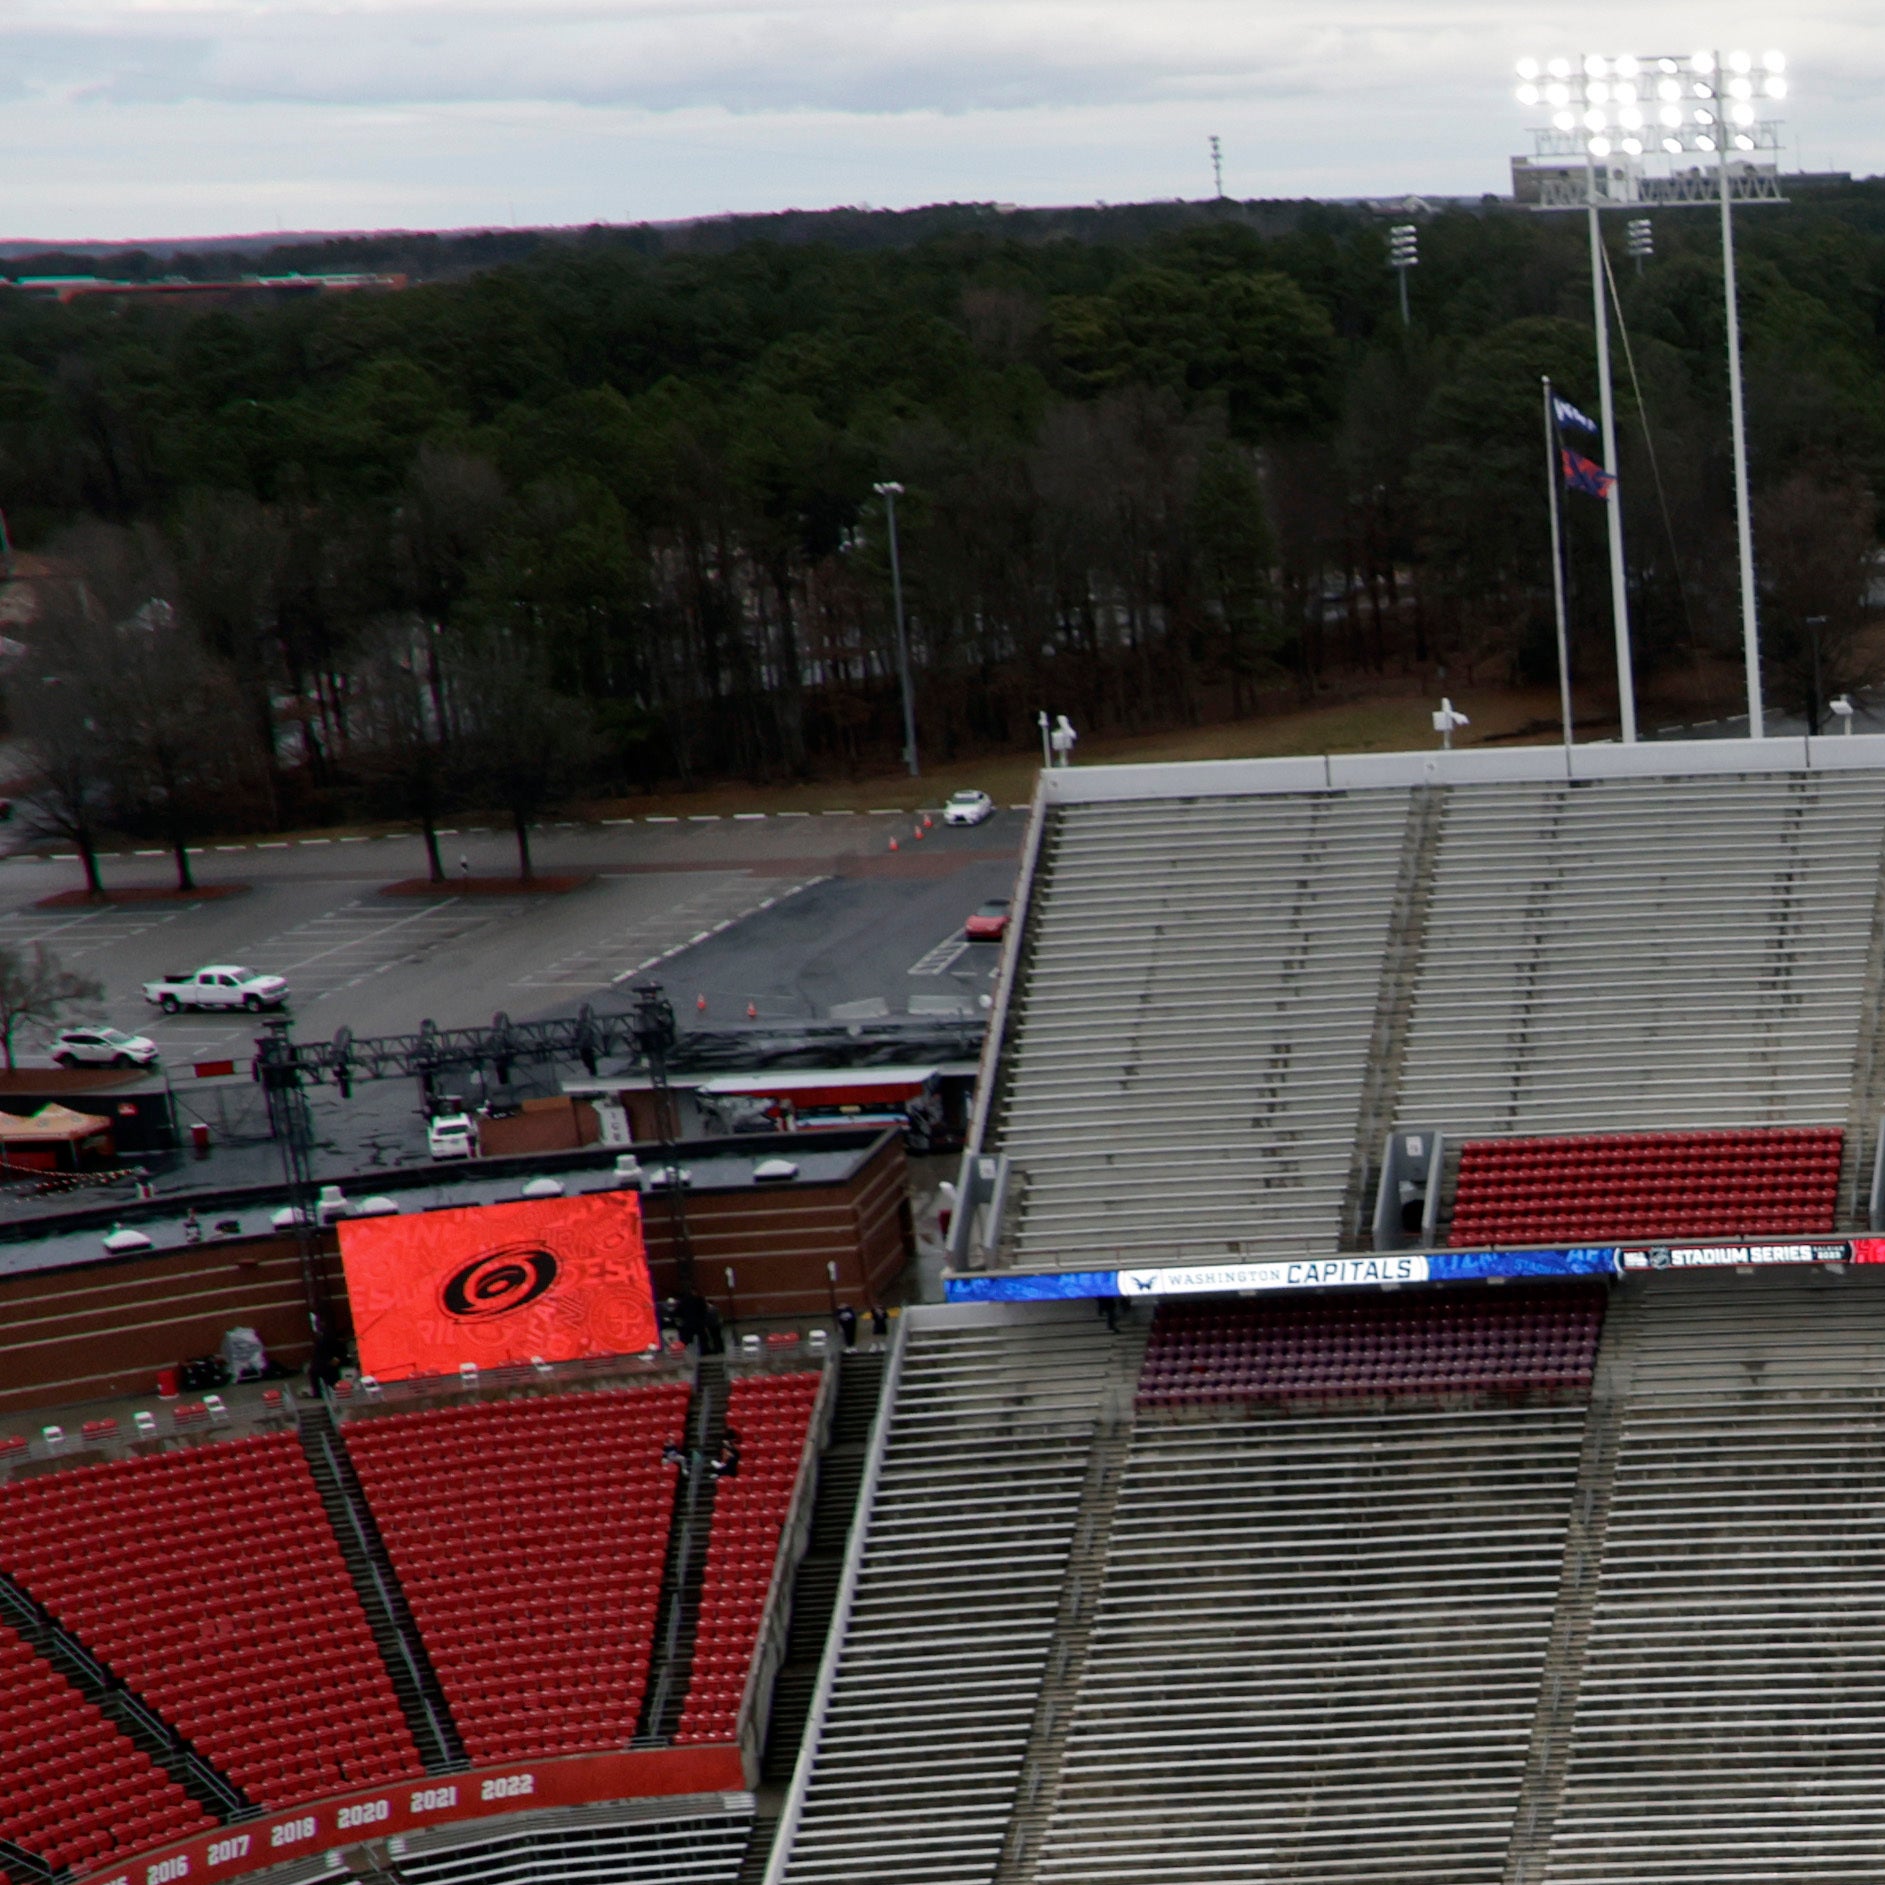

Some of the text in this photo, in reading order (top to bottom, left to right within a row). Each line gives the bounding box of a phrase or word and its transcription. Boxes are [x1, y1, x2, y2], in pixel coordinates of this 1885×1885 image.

[1671, 1247, 1748, 1266] STADIUM
[1751, 1245, 1811, 1263] SERIES
[1168, 1259, 1411, 1286] WASHINGTON CAPITALS
[207, 1835, 250, 1866] 2017
[271, 1817, 316, 1847] 2018
[337, 1800, 389, 1829] 2020
[411, 1786, 456, 1812] 2021
[482, 1773, 534, 1801] 2022
